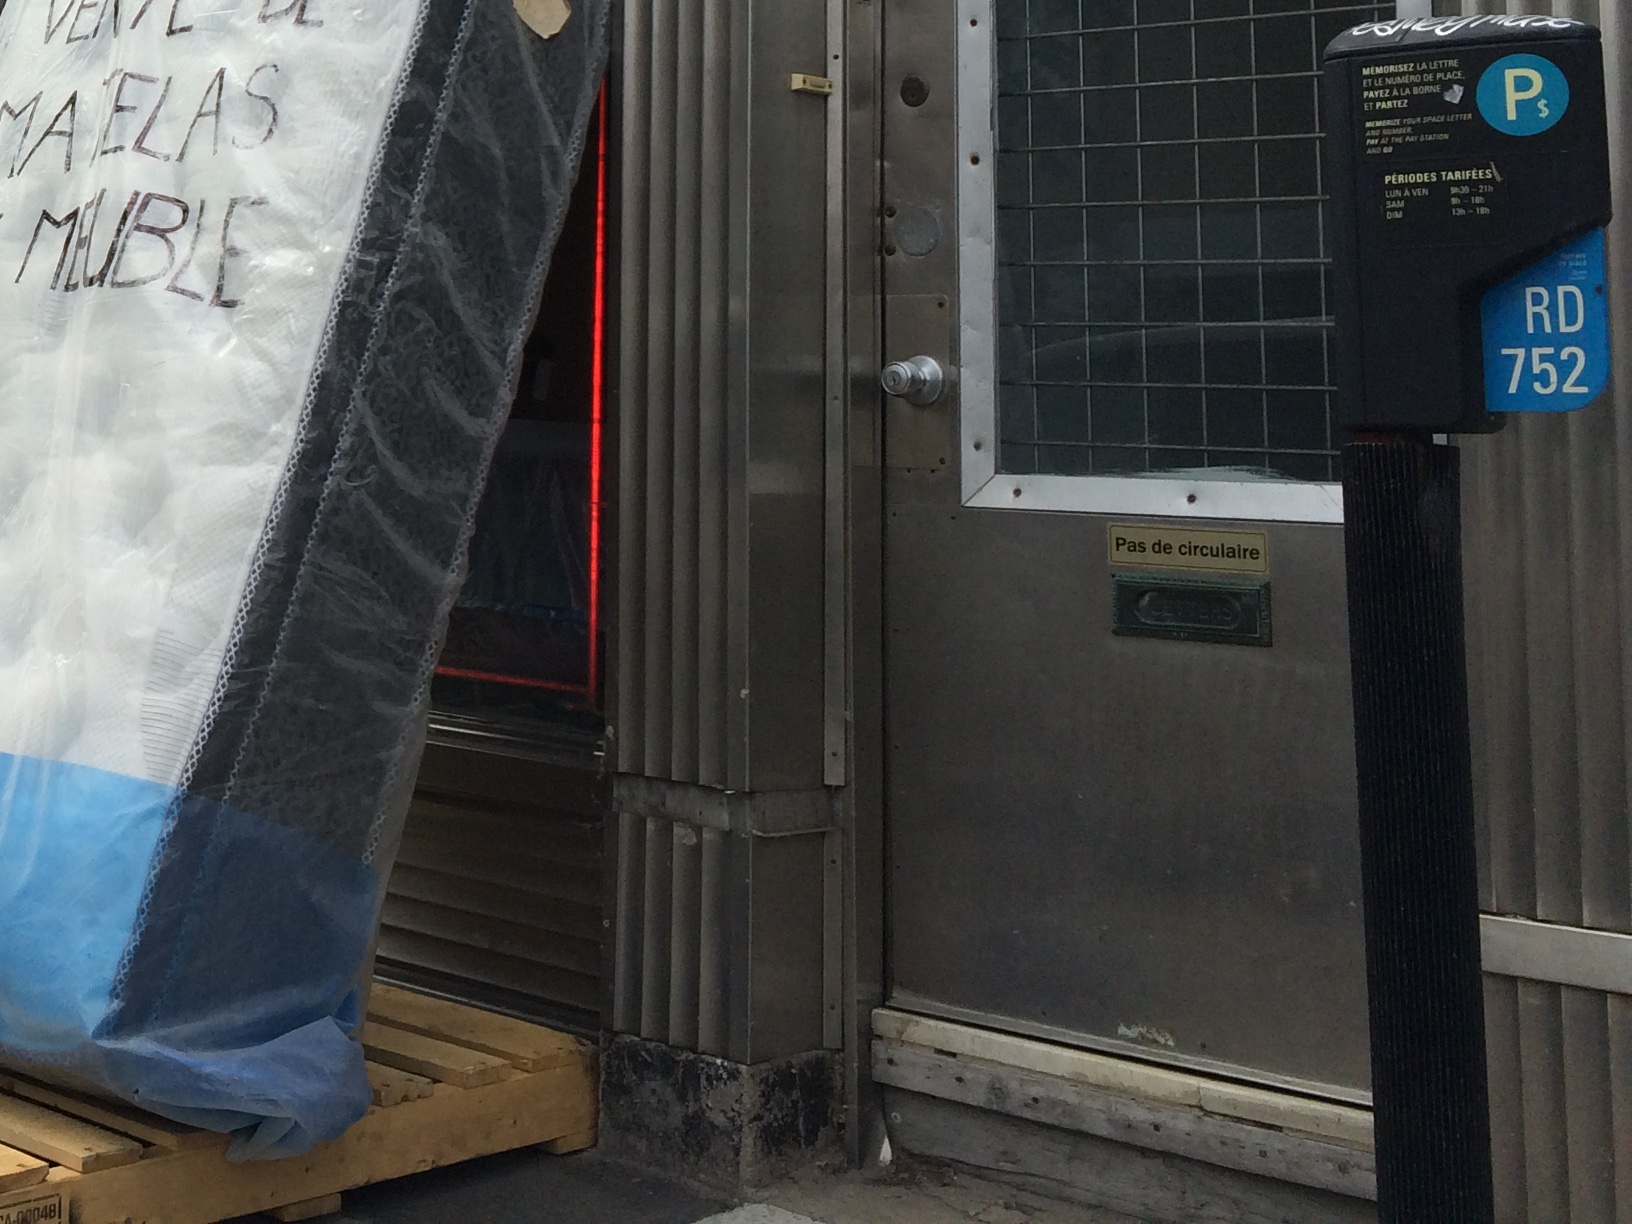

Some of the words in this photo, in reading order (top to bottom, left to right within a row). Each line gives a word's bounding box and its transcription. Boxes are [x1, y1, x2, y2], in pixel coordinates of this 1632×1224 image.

[1362, 62, 1415, 76] MÉMORISEZ
[1416, 61, 1428, 71] LA
[1429, 58, 1460, 70] LETTRE
[1362, 79, 1372, 88] ET
[1374, 78, 1384, 86] LE
[1423, 73, 1434, 82] DE
[1363, 88, 1390, 99] PAYEZ
[1400, 87, 1411, 96] LA
[1412, 84, 1442, 95] BORNE
[1364, 102, 1374, 111] ET
[1375, 99, 1408, 110] PARTEZ
[1384, 171, 1437, 185] PÉRIODES
[1440, 167, 1493, 182] TARIFÉES
[1385, 189, 1402, 198] LUN
[1412, 187, 1429, 197] VEN
[1385, 199, 1405, 209] SAM
[1386, 210, 1403, 220] DIM
[14, 187, 270, 309] MEUBLE
[1524, 284, 1585, 334] RD
[1500, 345, 1590, 395] 752
[1114, 536, 1147, 554] Pas
[1151, 538, 1174, 555] de
[1177, 540, 1261, 561] circulaire
